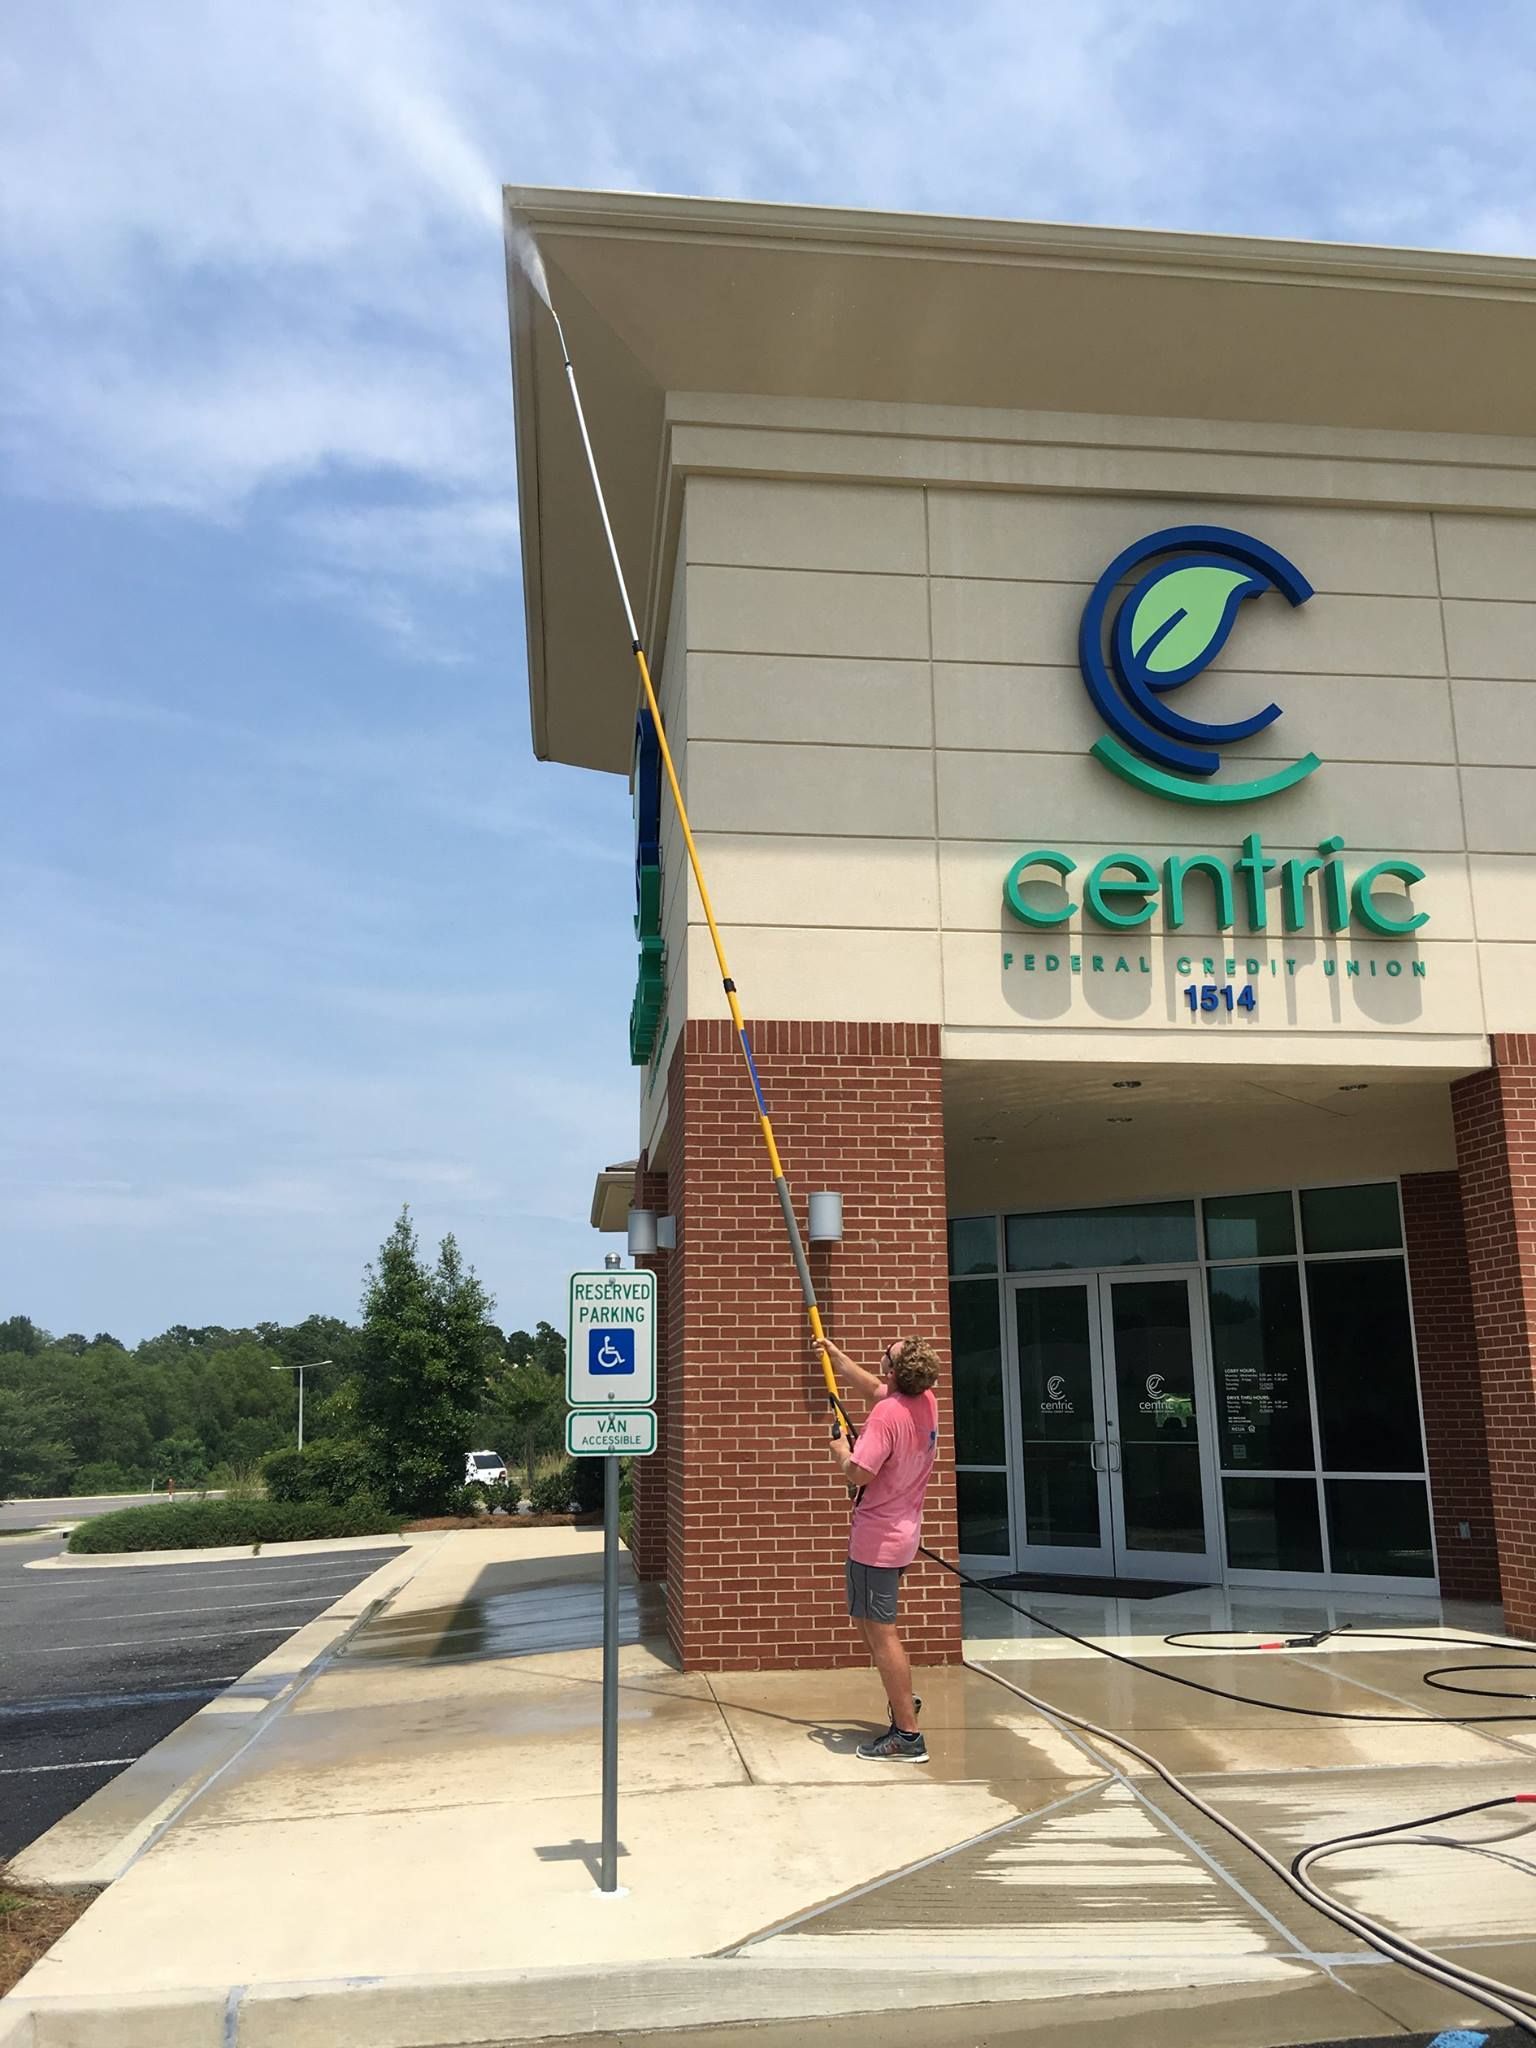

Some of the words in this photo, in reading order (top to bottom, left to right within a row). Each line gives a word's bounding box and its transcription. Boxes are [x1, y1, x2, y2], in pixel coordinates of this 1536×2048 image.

[1003, 833, 1431, 937] centric
[1003, 952, 1151, 975] FEDERAL
[1177, 956, 1297, 977] CREDIT
[1323, 958, 1428, 978] UNION
[1184, 984, 1257, 1012] 1514
[575, 1283, 651, 1301] RESERVED
[579, 1306, 645, 1323] PARKING
[1040, 1399, 1074, 1410] centric
[1139, 1399, 1174, 1410] centric
[597, 1419, 627, 1433] VAN
[581, 1435, 642, 1446] ACCESSIBLE
